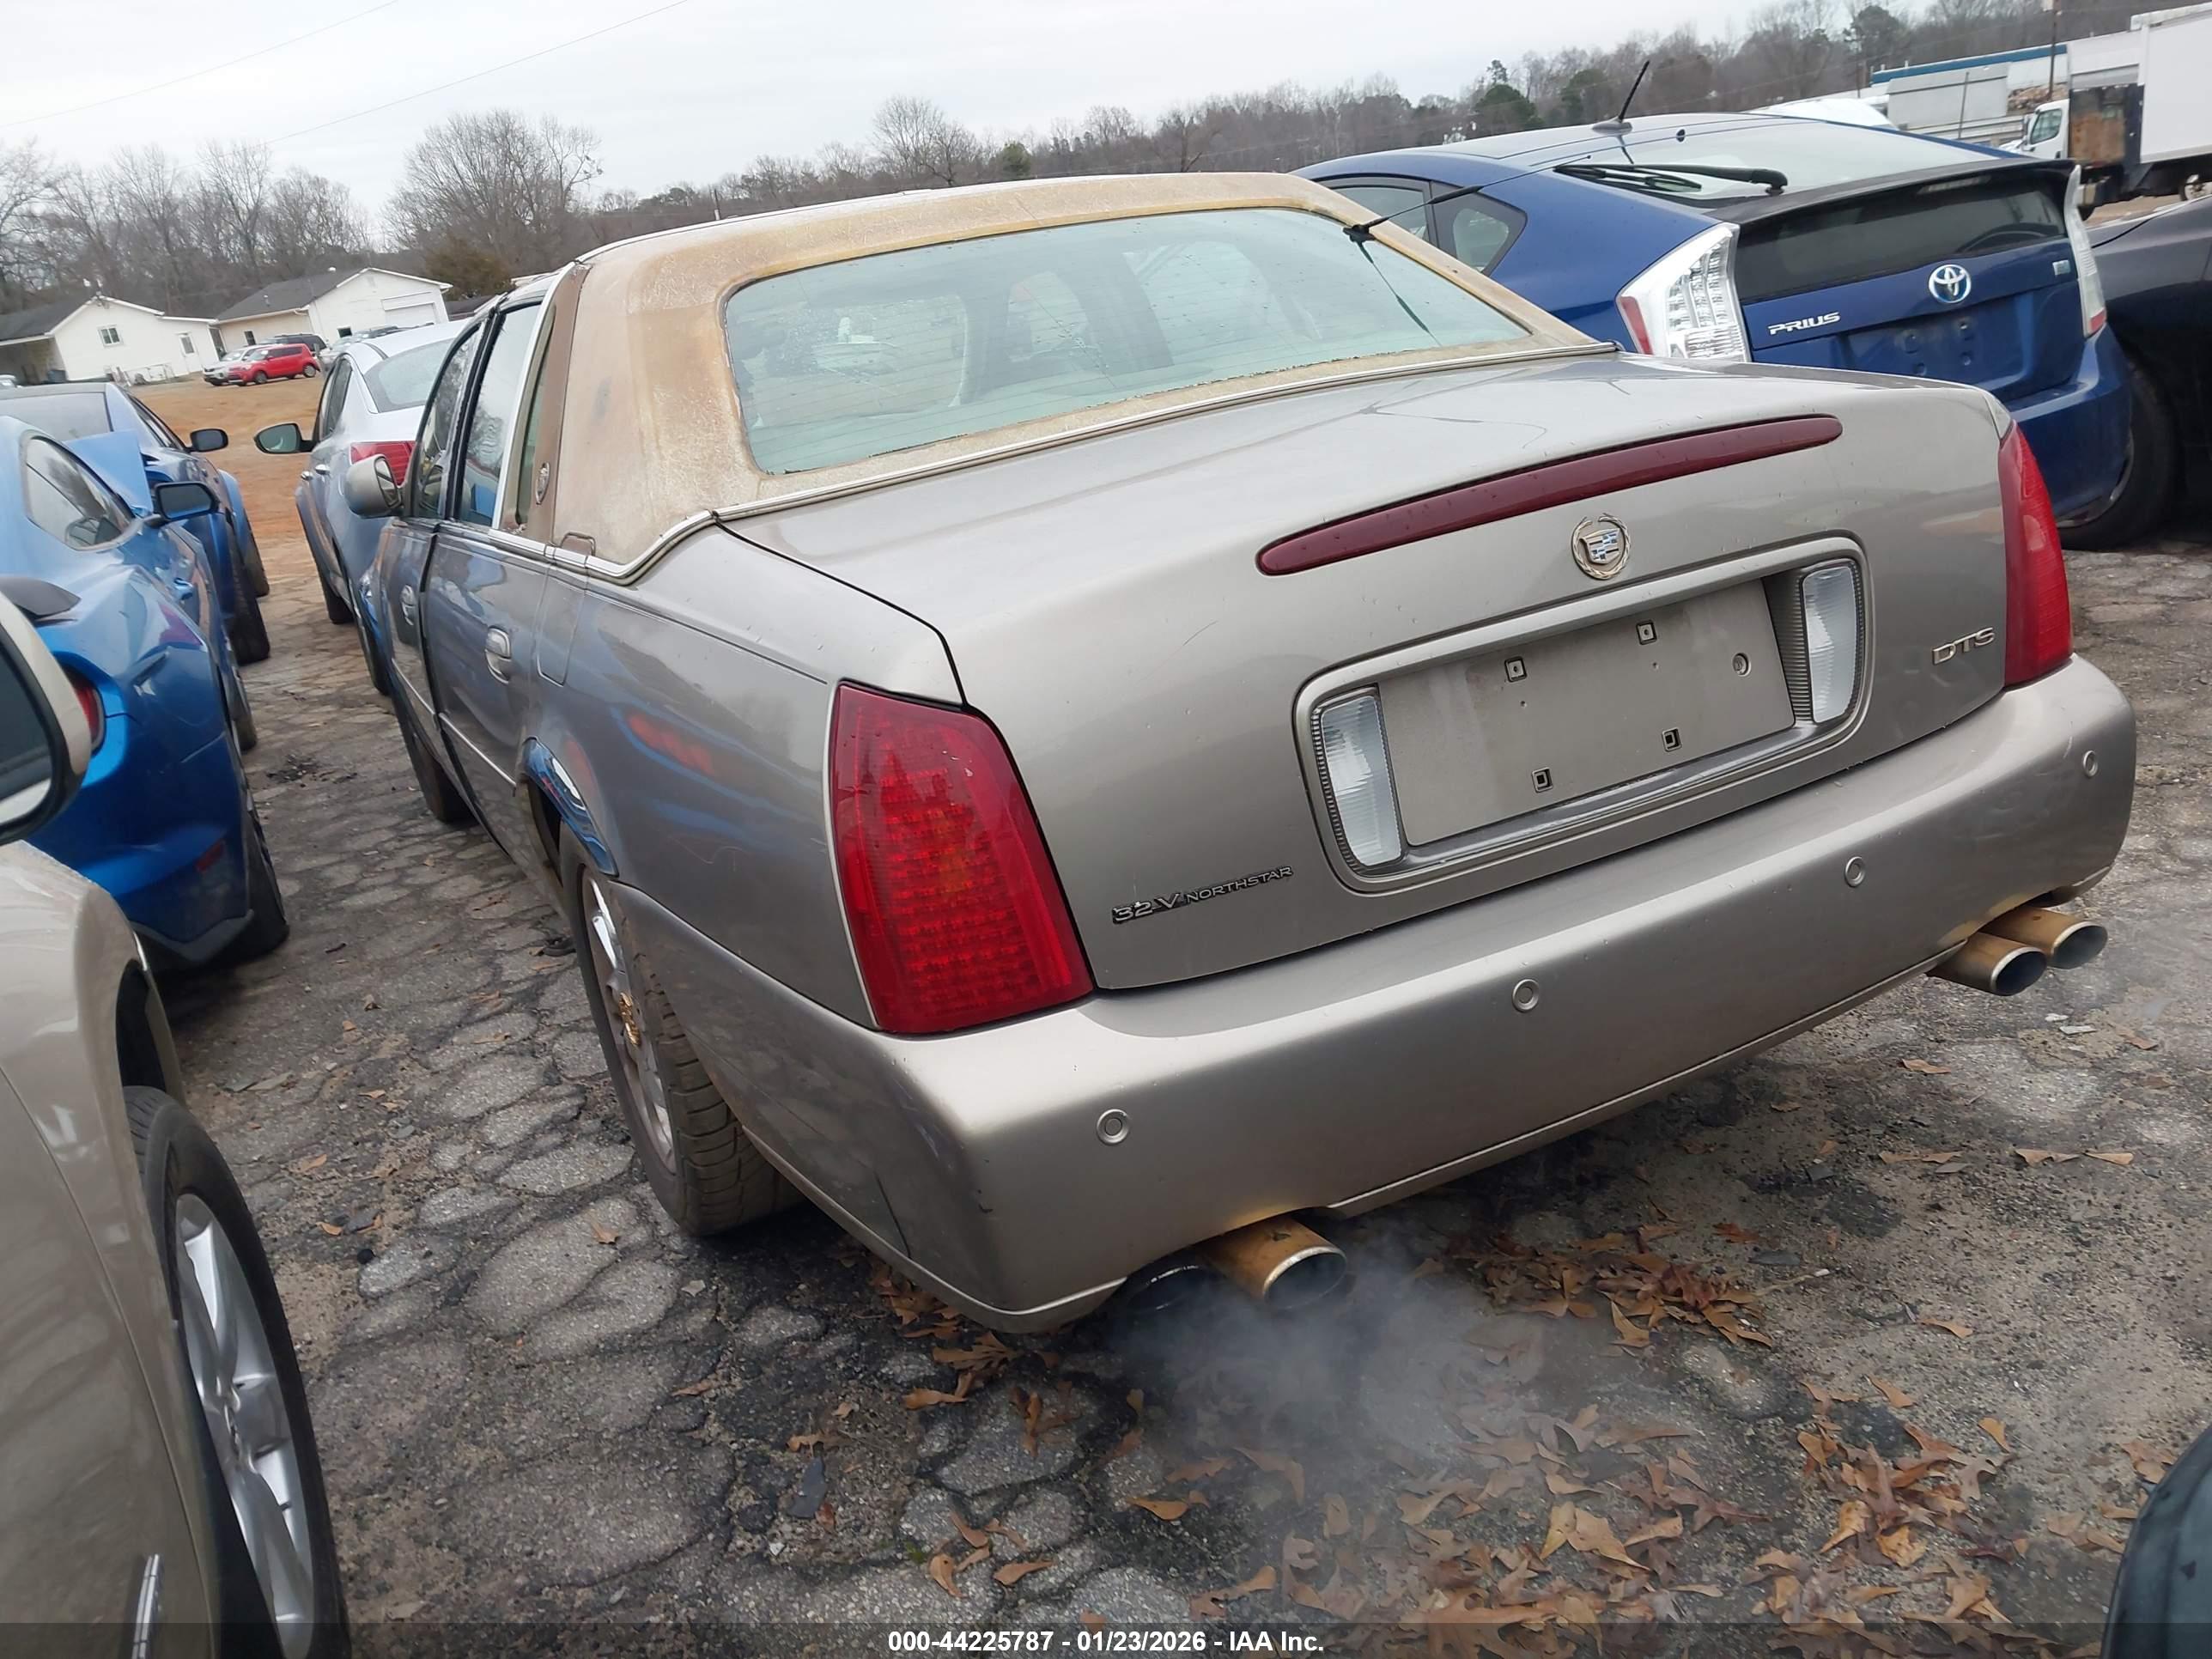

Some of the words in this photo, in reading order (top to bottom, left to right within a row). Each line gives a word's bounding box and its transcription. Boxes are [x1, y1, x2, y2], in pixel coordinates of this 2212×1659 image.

[1768, 311, 1841, 335] PRIUS
[1932, 627, 1995, 665] DTS
[1185, 866, 1293, 903] NORTHSTAR
